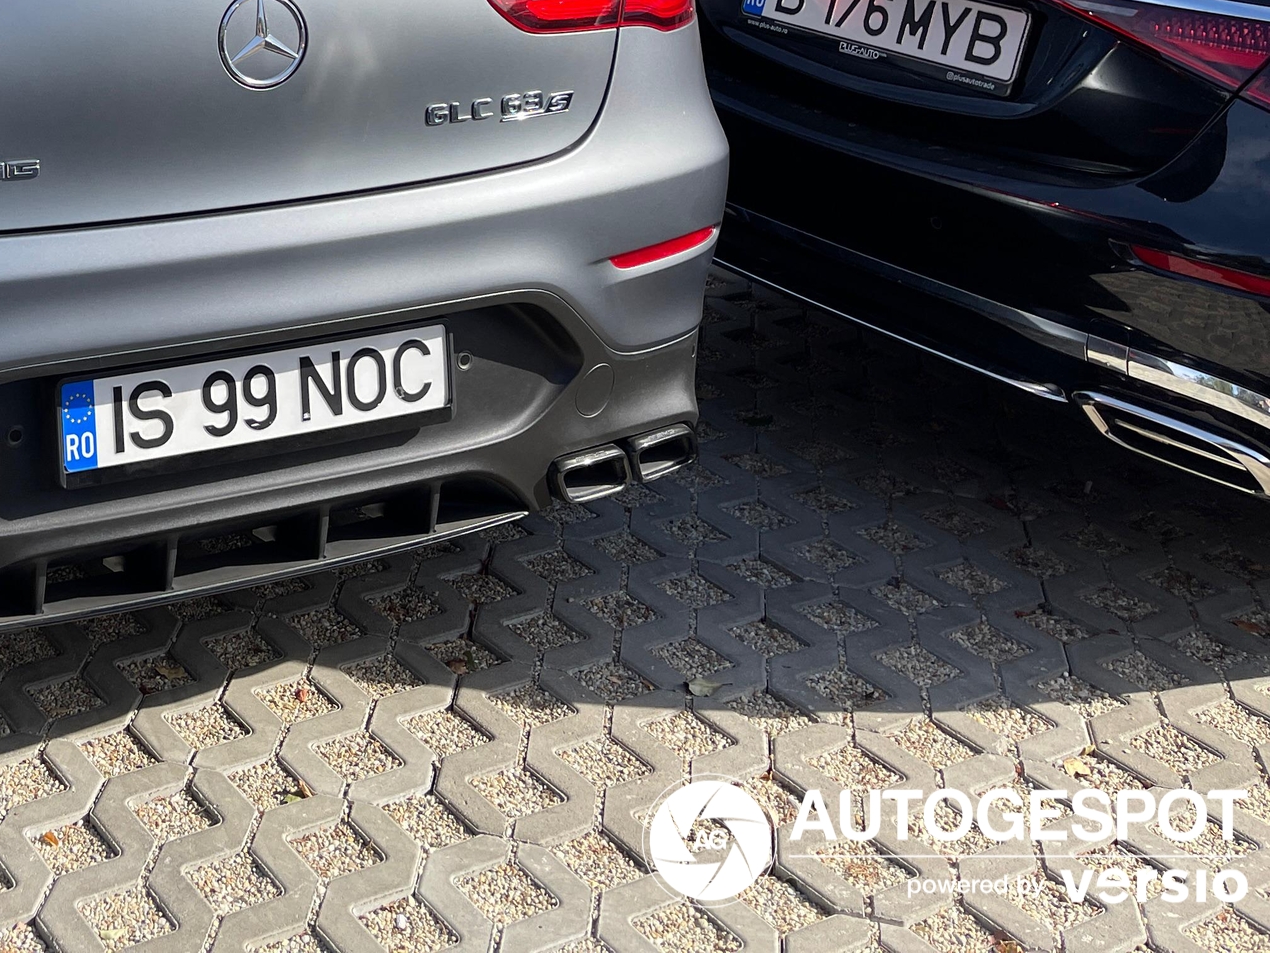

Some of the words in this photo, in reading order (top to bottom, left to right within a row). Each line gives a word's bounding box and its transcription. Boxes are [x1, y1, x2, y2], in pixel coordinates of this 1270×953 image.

[425, 97, 494, 127] GLC
[111, 378, 174, 455] IS
[201, 363, 279, 438] 99
[297, 338, 433, 423] NOC
[65, 430, 96, 463] RO
